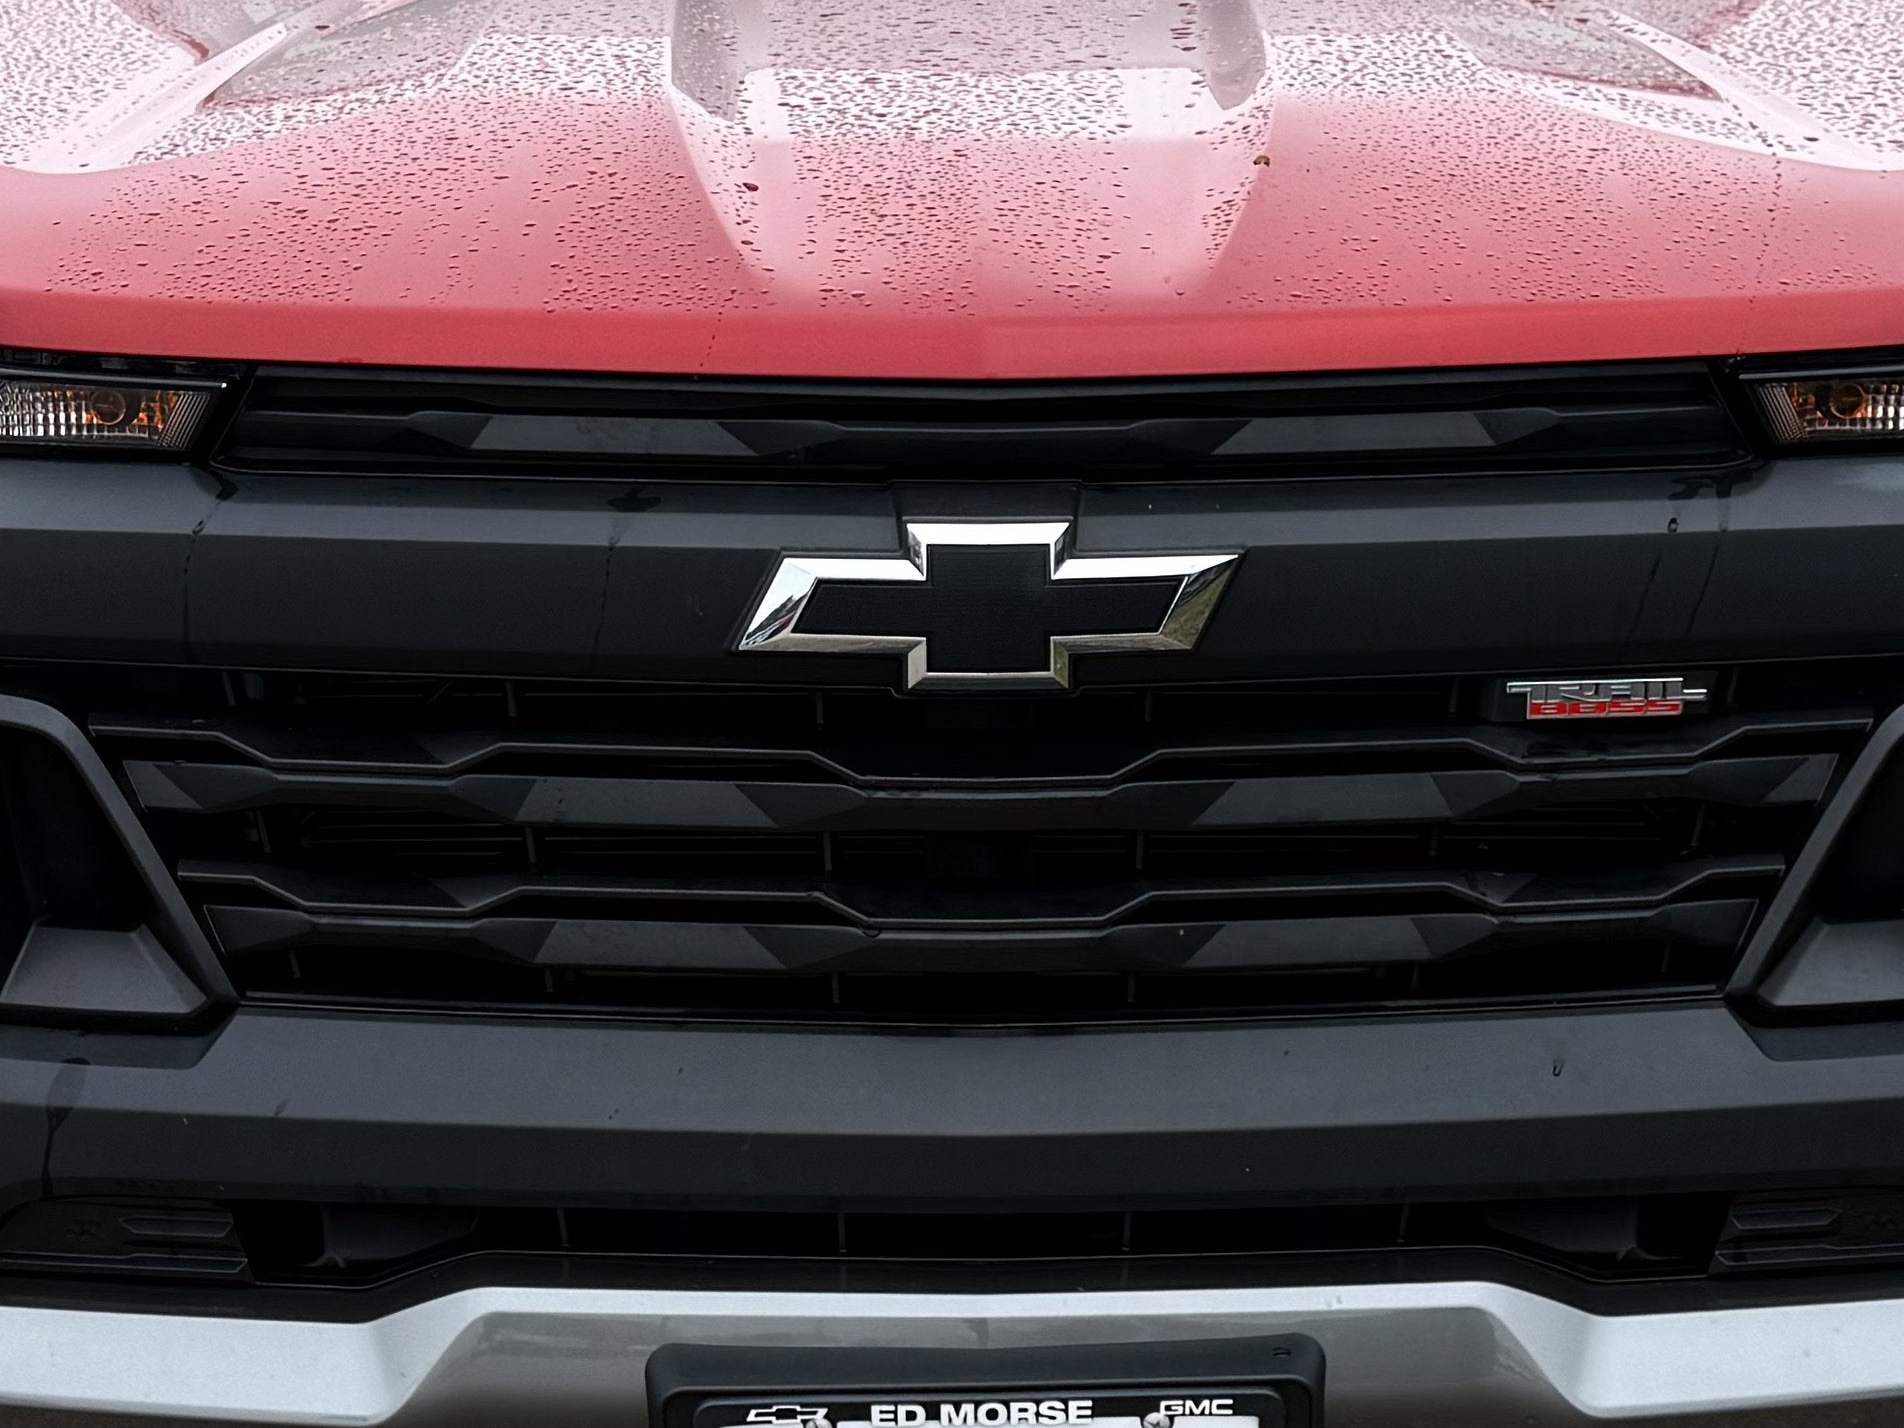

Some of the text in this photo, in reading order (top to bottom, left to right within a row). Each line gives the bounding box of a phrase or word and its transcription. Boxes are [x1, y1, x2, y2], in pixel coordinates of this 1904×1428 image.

[1507, 677, 1707, 702] TRAIL
[1528, 699, 1683, 719] BOSS
[870, 1400, 1093, 1428] ED MORSE
[1160, 1399, 1234, 1416] GMC
